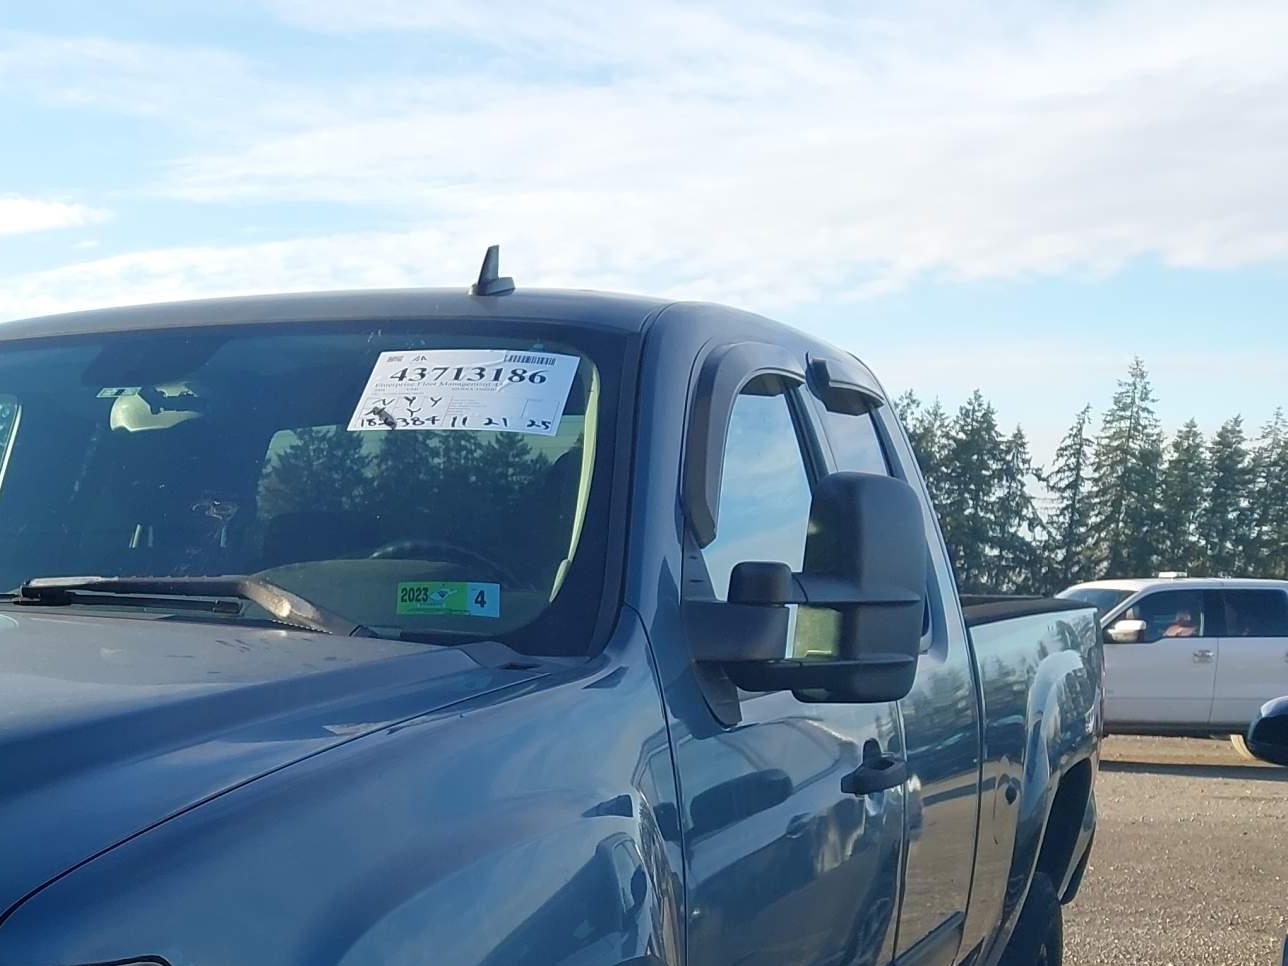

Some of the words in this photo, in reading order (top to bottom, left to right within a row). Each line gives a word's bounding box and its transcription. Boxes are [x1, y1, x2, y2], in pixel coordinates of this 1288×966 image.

[390, 366, 549, 384] 43713186
[451, 416, 468, 428] 11
[483, 417, 509, 428] 21
[526, 418, 552, 431] 25
[400, 586, 430, 603] 2023
[474, 589, 487, 608] 4
